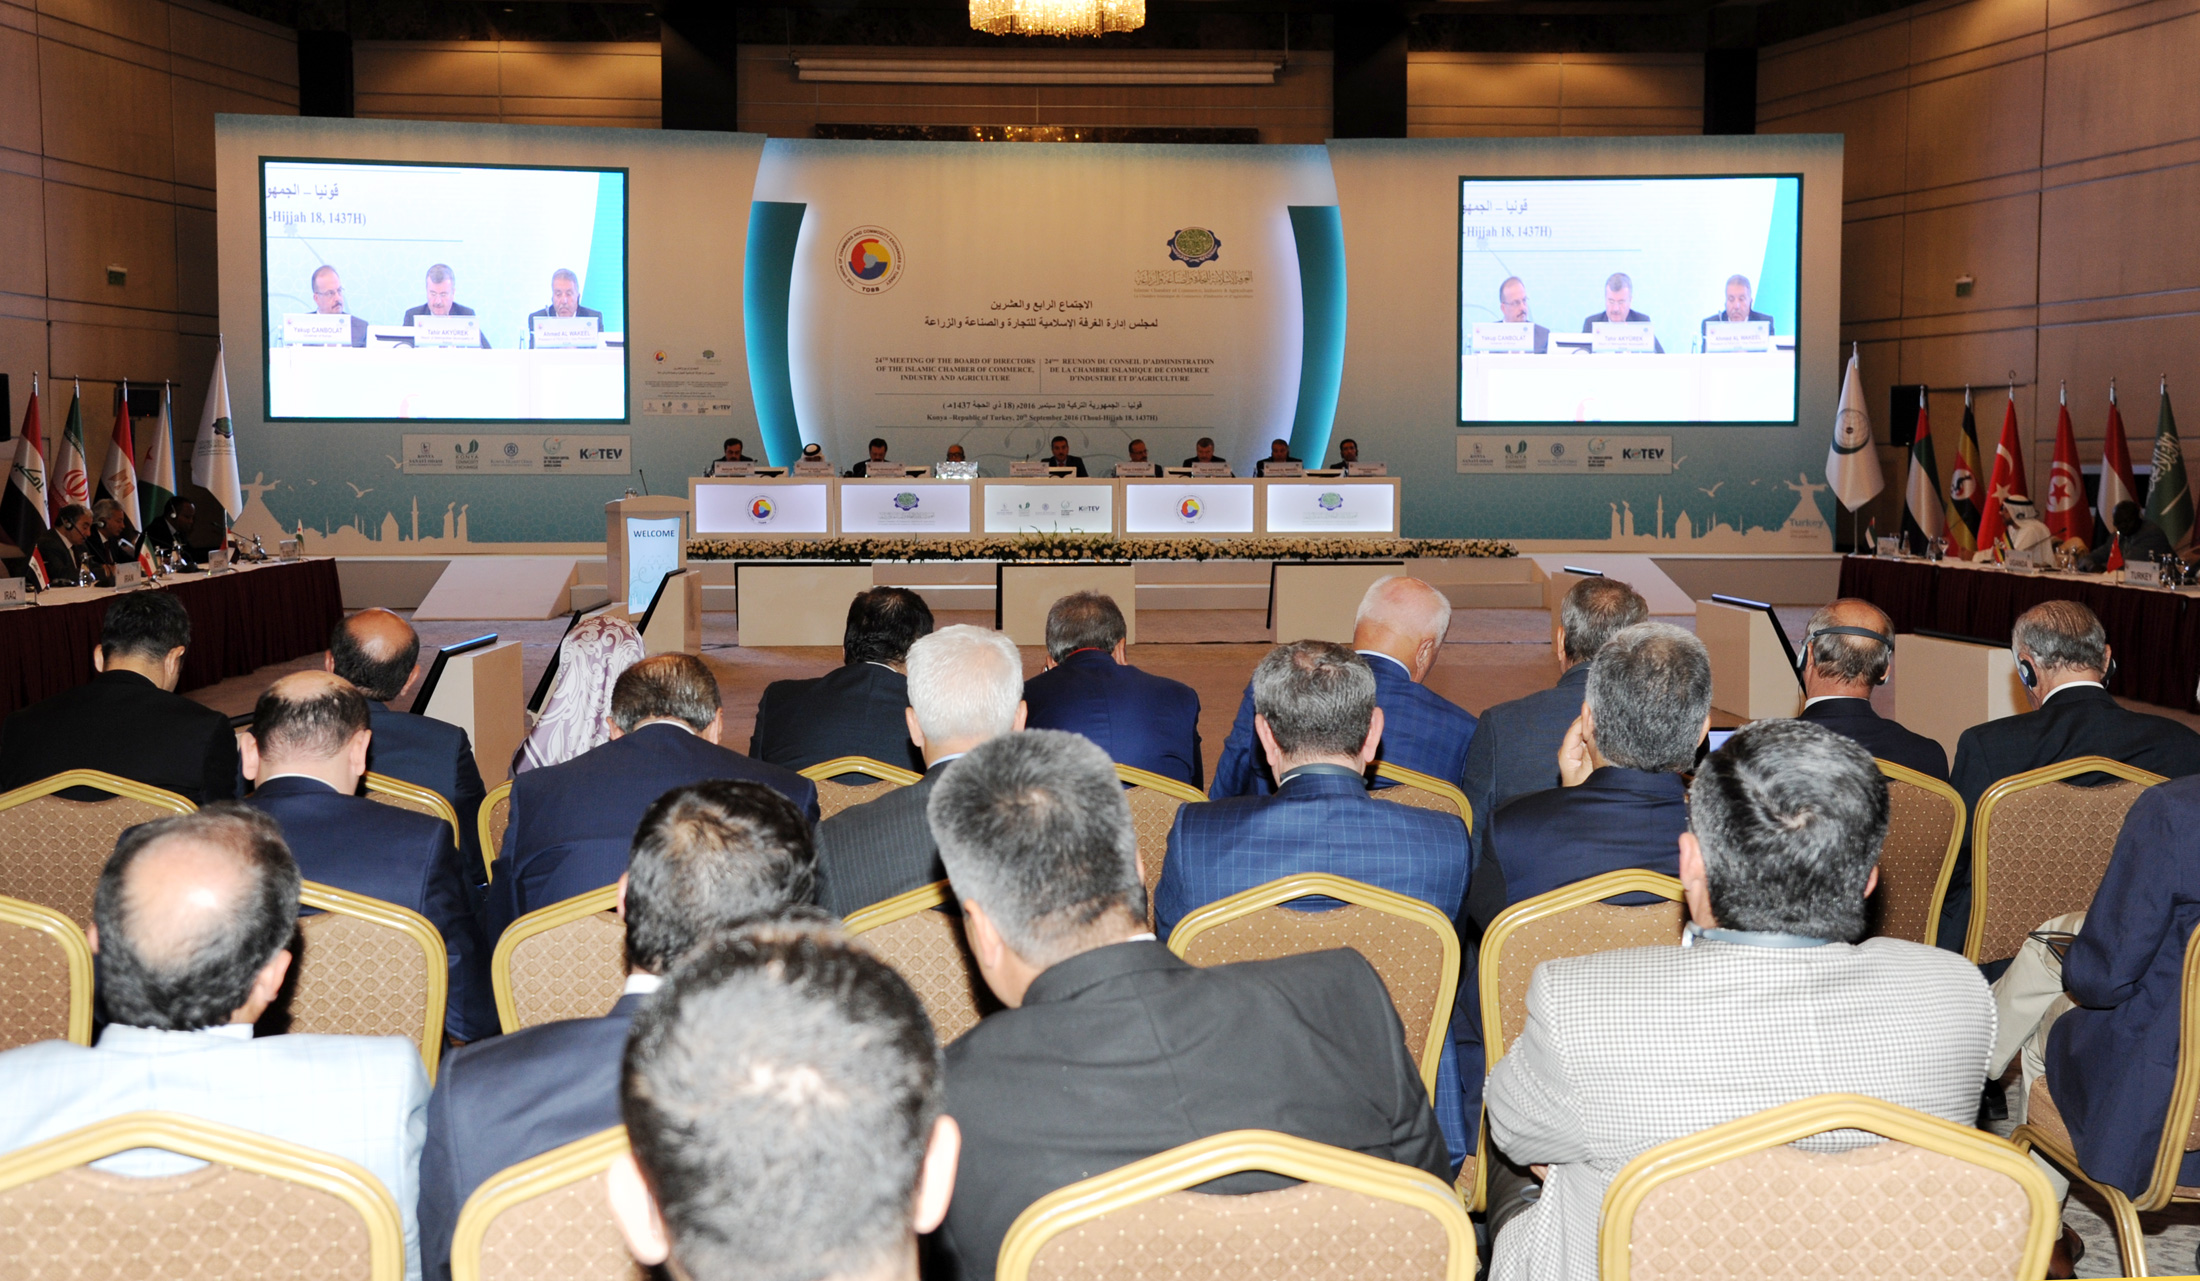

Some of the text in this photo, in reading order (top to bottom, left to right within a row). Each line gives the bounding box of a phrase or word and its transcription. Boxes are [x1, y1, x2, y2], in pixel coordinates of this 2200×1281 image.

[315, 183, 338, 200] قونيا
[1506, 198, 1528, 215] قونيا
[311, 212, 326, 226] 18,
[329, 212, 367, 227] 1437H)
[1501, 226, 1515, 238] 18,
[1518, 226, 1552, 240] 1437H)
[991, 299, 1093, 312] الاجتماع الرابع والعشرين
[924, 316, 1159, 330] لمجلس إدارة الغرفة الإسلامية للتجارة والصناعة والزراعة
[1111, 366, 1153, 374] ISLAMIQUE
[1029, 414, 1062, 422] September
[1135, 414, 1158, 422] 1437H)
[1789, 518, 1824, 529] Turkey
[633, 529, 676, 538] WELCOME
[124, 574, 134, 582] IRAN
[2130, 571, 2152, 582] TURKEY
[4, 590, 17, 600] IRAQ
